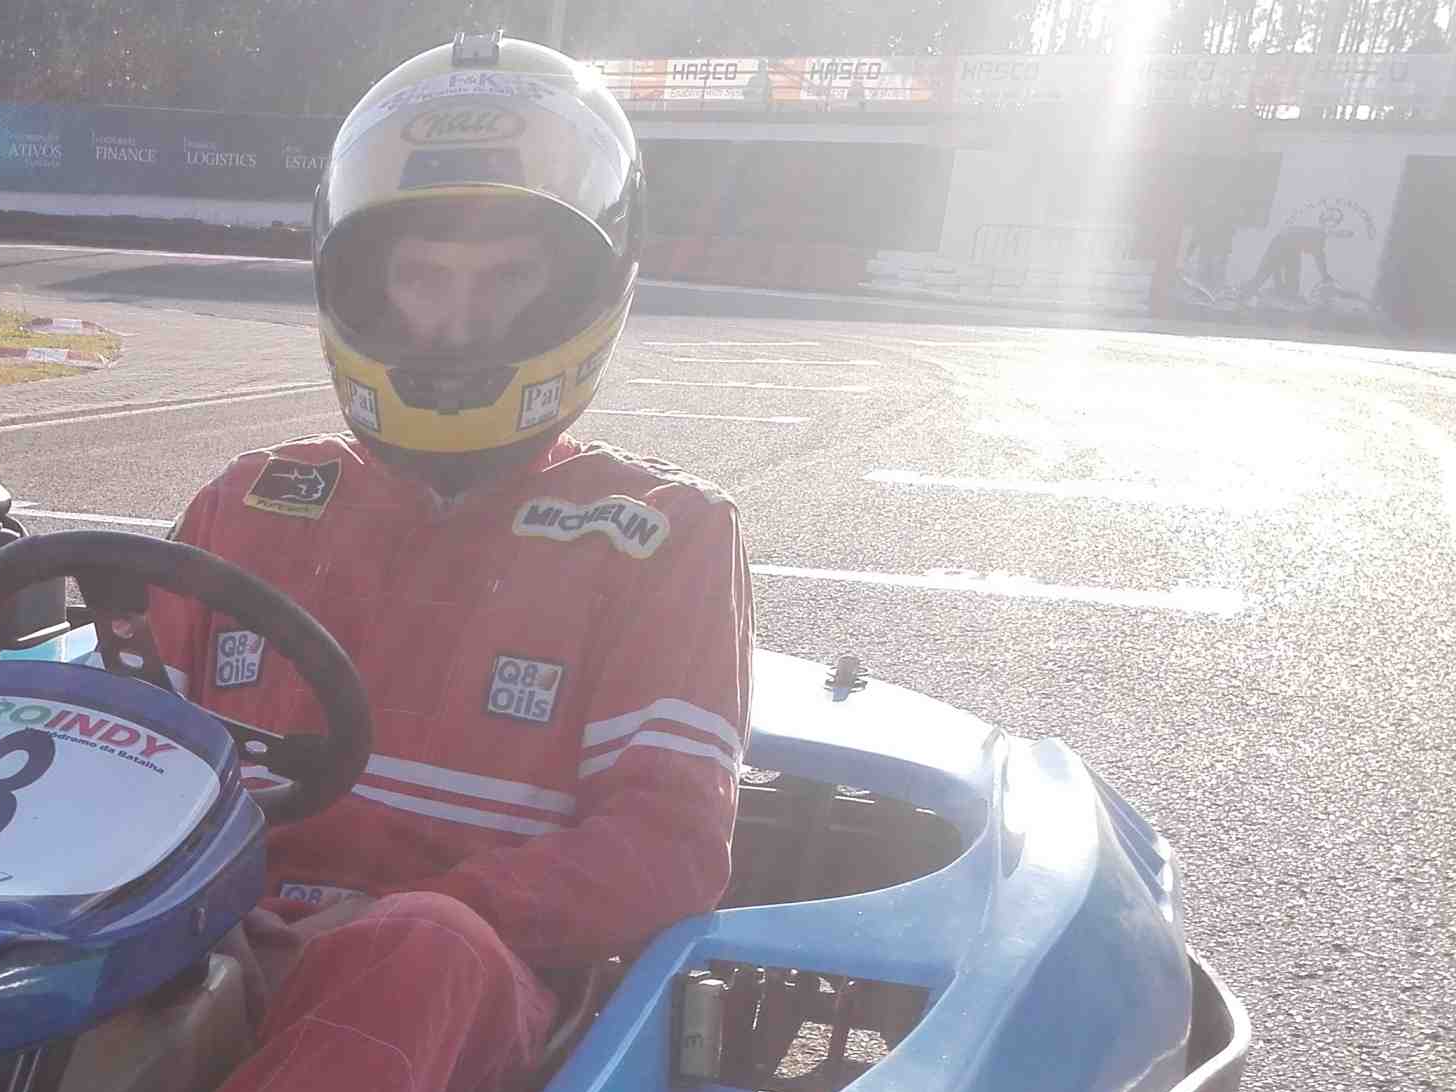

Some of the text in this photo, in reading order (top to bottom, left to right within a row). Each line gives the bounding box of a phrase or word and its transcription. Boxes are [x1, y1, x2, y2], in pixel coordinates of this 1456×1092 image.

[672, 62, 738, 81] HASCO
[810, 62, 883, 81] HASCO
[95, 145, 157, 164] FINANCE
[186, 150, 257, 168] LOGISTICS
[522, 502, 660, 548] MICHELIN
[219, 634, 248, 658] Q8
[217, 659, 257, 684] Oils
[496, 659, 538, 687] Q8
[490, 687, 548, 719] Oils
